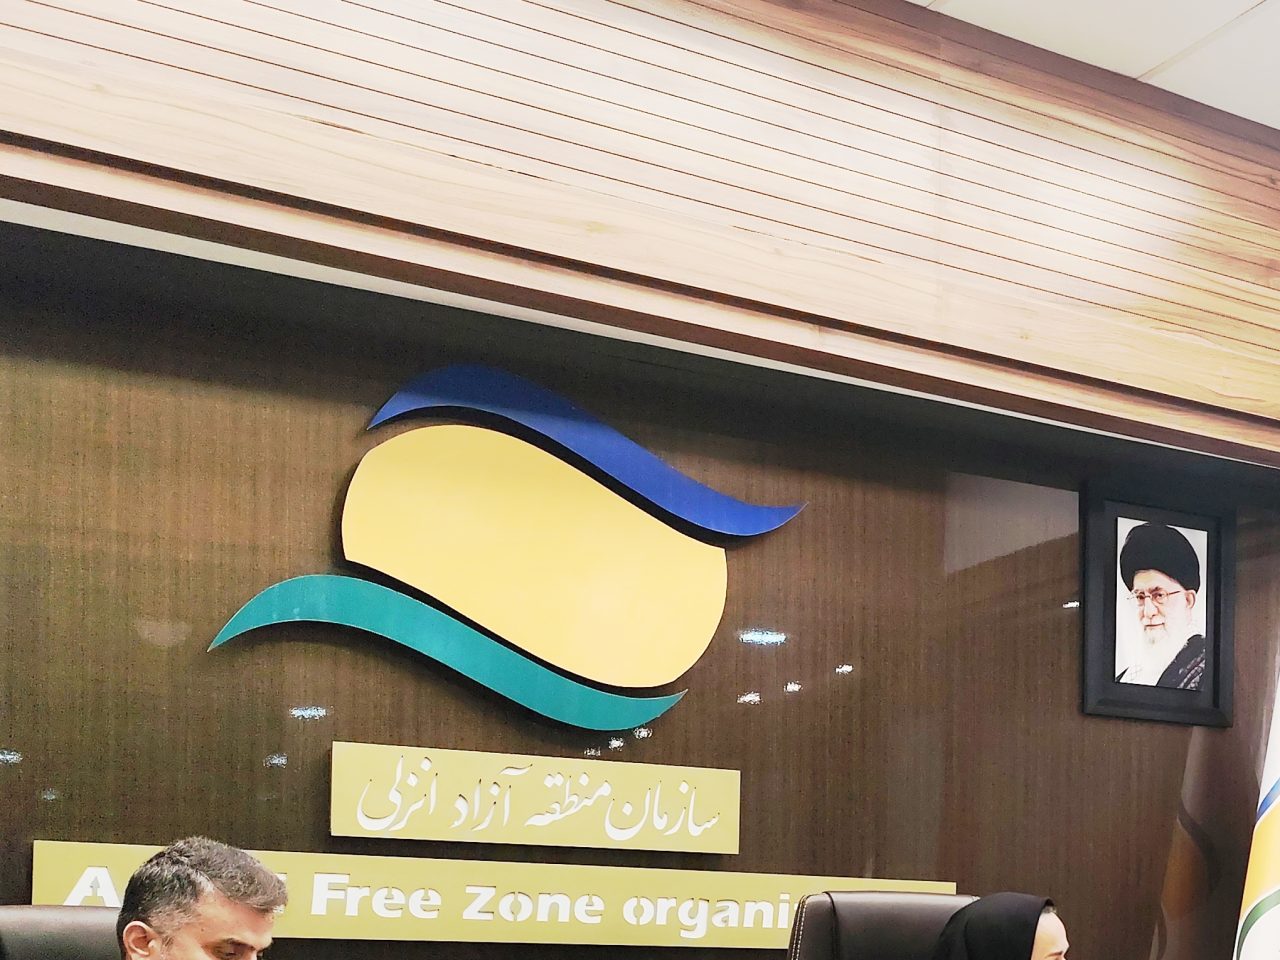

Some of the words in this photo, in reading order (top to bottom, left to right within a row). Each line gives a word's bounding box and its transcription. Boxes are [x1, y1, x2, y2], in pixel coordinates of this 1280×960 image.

[356, 755, 438, 832] انزلی
[450, 763, 534, 831] آزاد
[524, 772, 612, 827] منطقه
[604, 780, 721, 841] سازمان
[310, 872, 442, 919] Free
[462, 884, 605, 925] Zone
[622, 892, 802, 939] organi
